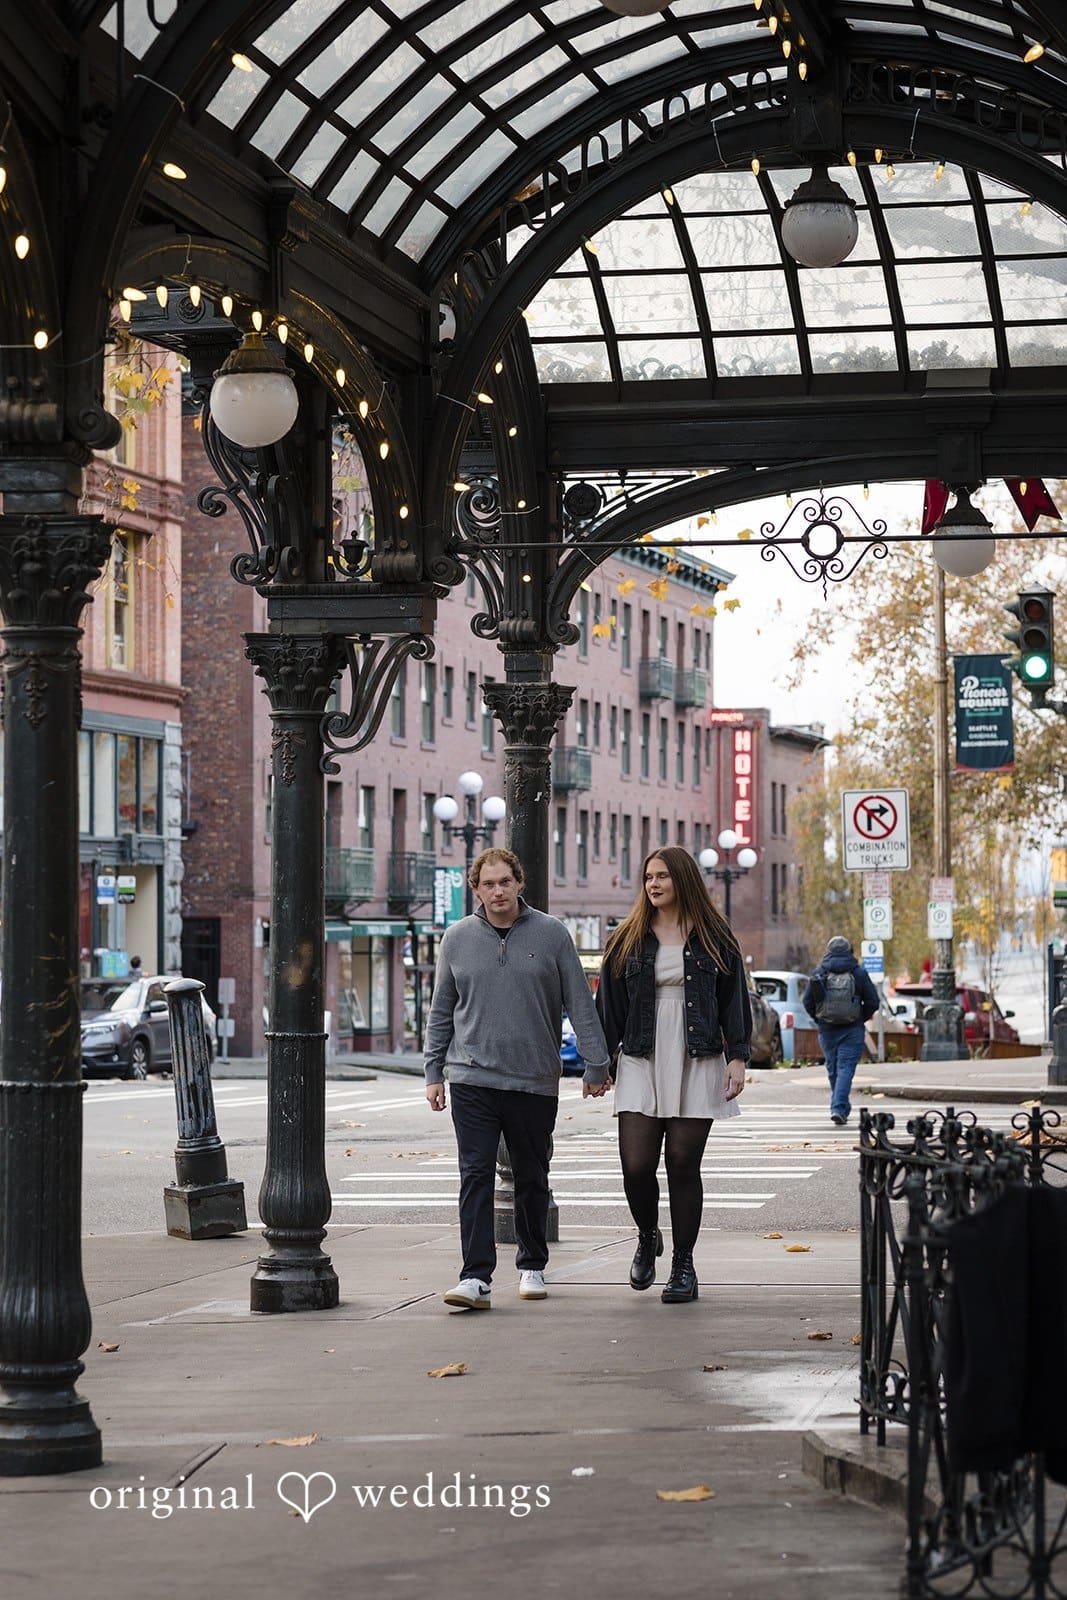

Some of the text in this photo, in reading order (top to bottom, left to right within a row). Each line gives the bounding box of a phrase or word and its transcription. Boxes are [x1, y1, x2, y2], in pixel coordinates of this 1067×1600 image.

[959, 675, 1008, 698] Pioneer
[959, 697, 1009, 708] SQUARE
[734, 730, 751, 844] HOTEL
[847, 841, 906, 853] COMBINATION
[860, 854, 895, 865] TRUCKS
[434, 869, 446, 924] SQUARE
